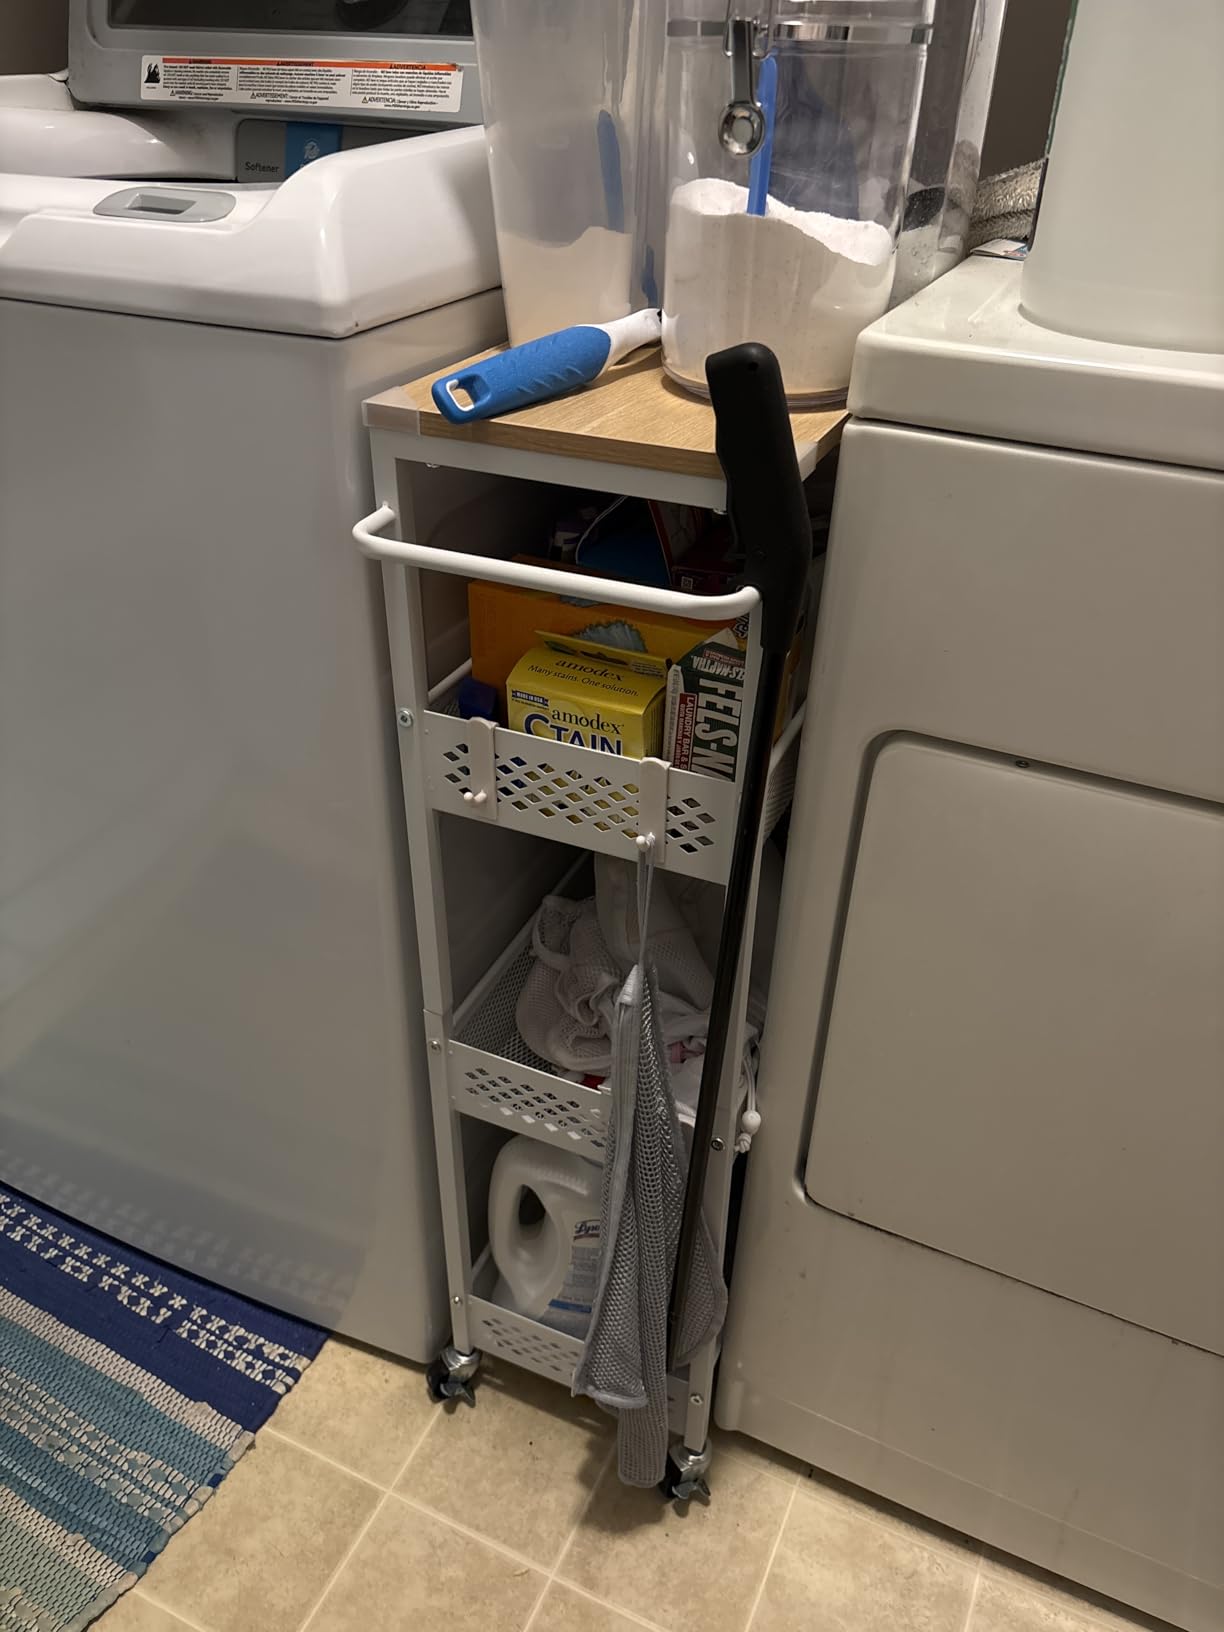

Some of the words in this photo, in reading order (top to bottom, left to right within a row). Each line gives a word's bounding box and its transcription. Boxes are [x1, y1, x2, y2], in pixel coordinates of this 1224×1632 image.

[245, 161, 280, 173] Softener
[528, 664, 554, 677] Many
[551, 669, 579, 683] stains.
[581, 677, 600, 688] One
[601, 681, 639, 697] solution.
[555, 659, 625, 682] amodex
[551, 708, 623, 736] amodex
[683, 696, 694, 736] LAUNDRY
[681, 738, 690, 755] BAR
